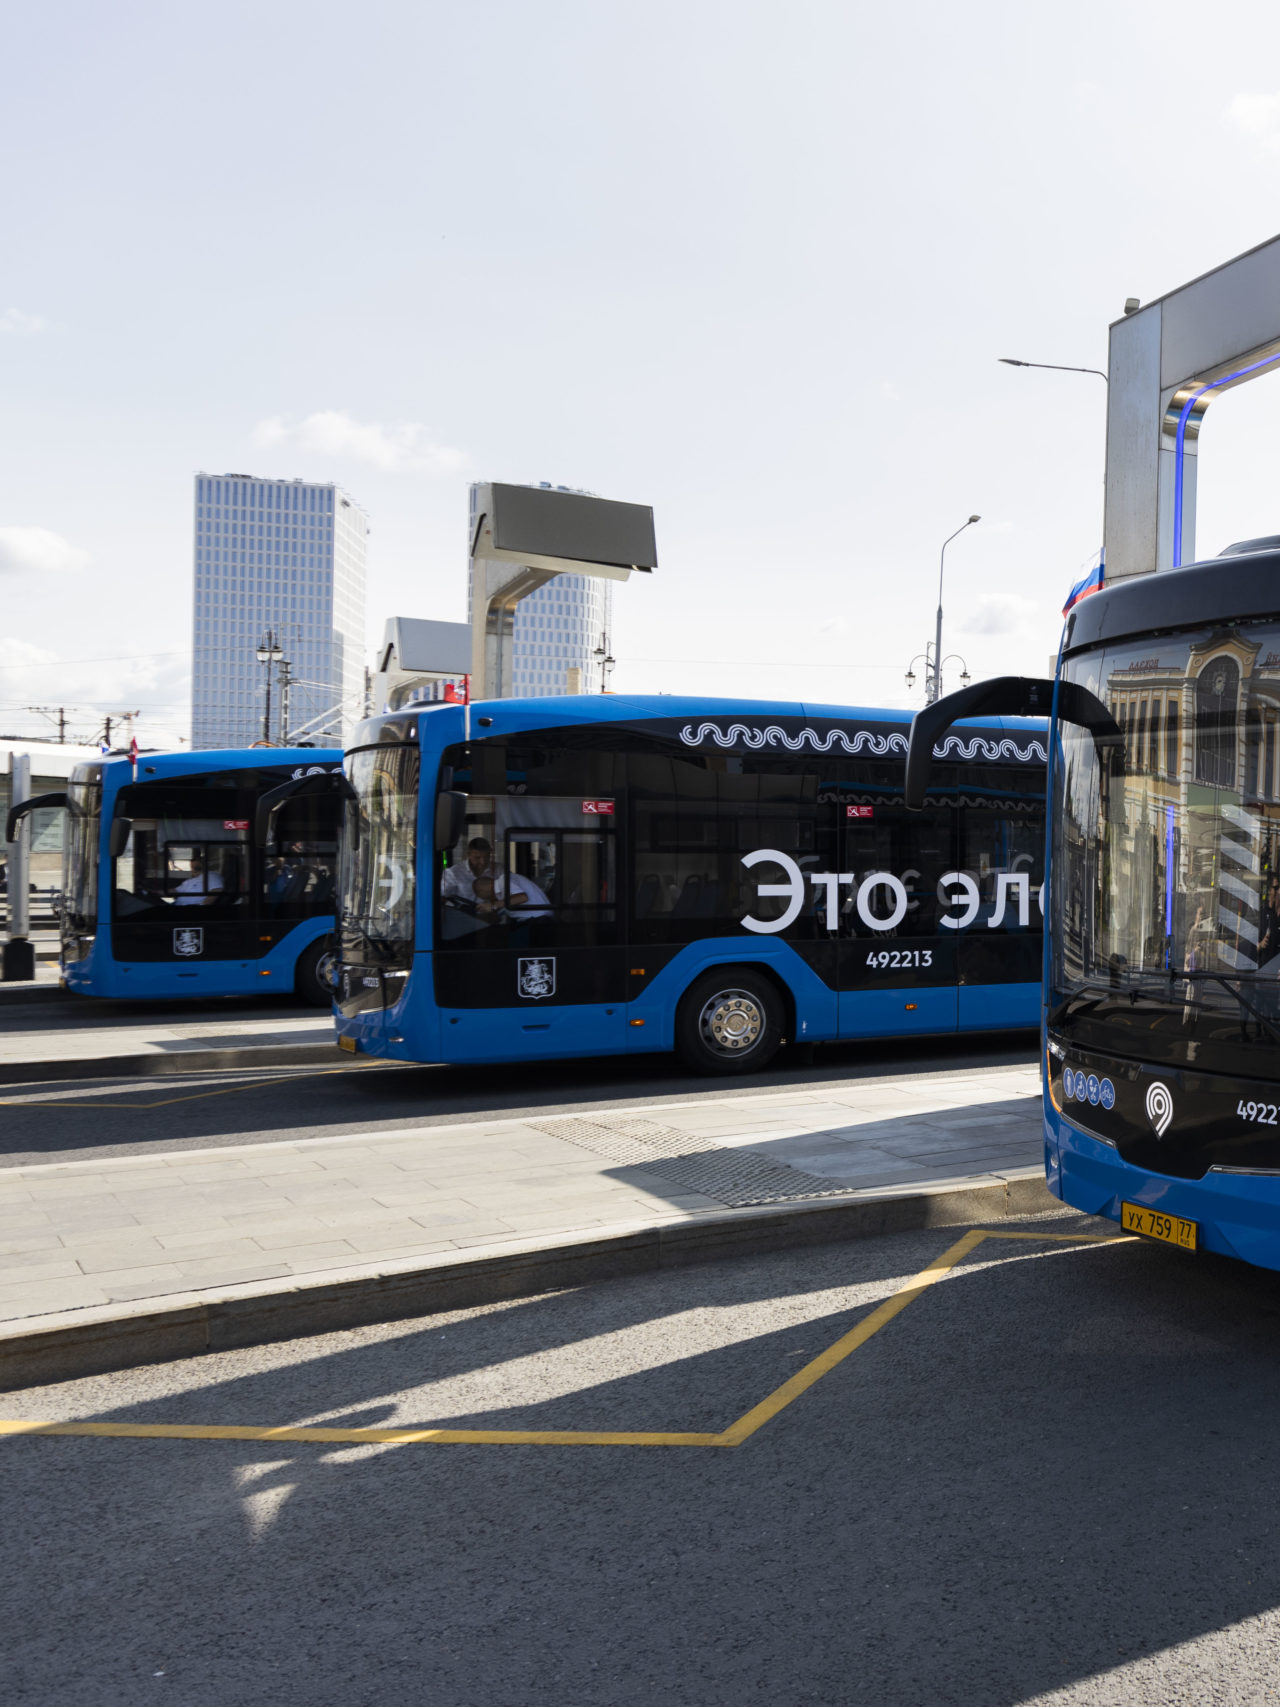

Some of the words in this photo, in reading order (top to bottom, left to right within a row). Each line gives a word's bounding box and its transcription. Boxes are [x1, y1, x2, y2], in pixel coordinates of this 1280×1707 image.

[740, 849, 908, 934] Это
[939, 872, 1044, 929] эл
[866, 950, 933, 969] 492213
[1148, 1213, 1172, 1238] 759
[1179, 1221, 1192, 1239] 77
